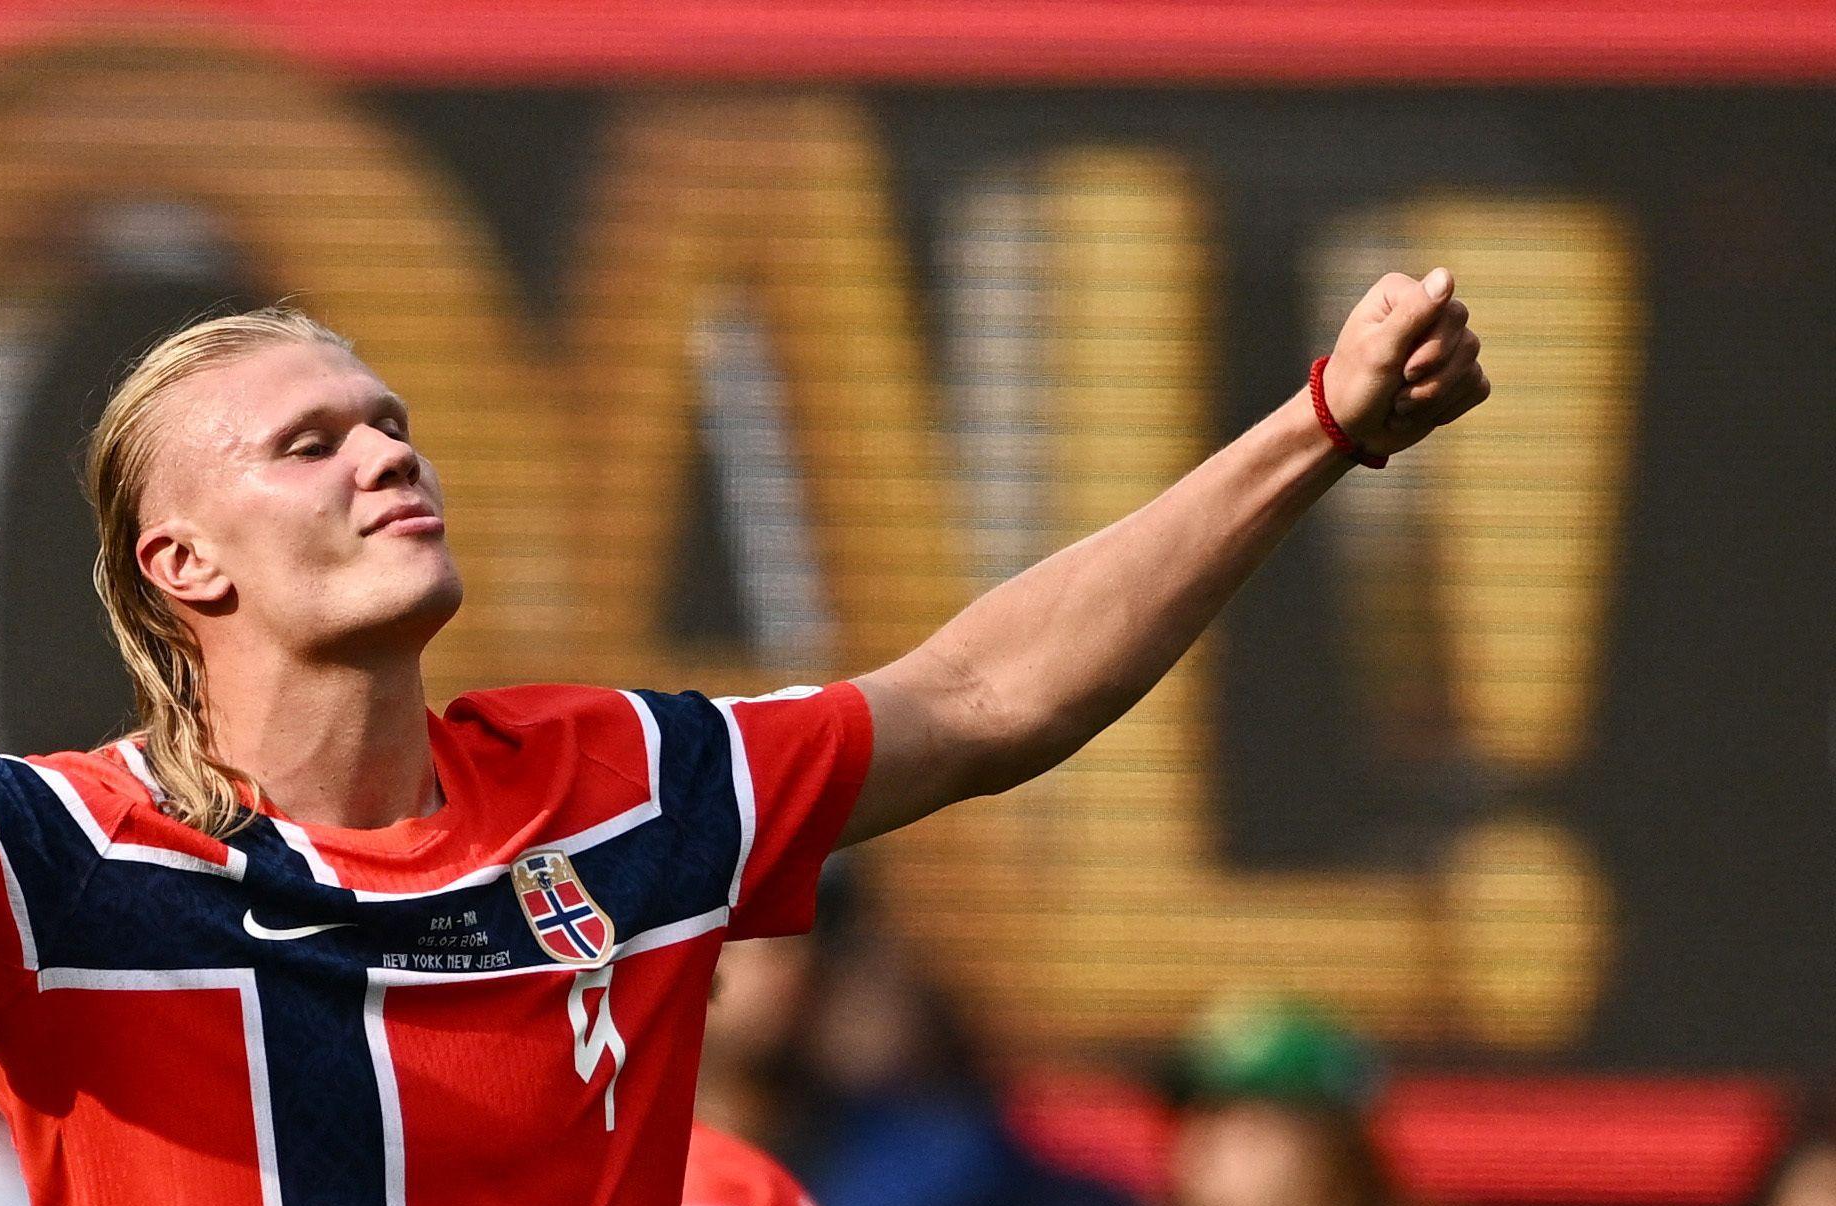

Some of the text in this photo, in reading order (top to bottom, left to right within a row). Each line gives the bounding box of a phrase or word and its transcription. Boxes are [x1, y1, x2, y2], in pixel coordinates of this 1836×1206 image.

[382, 953, 408, 969] NEW
[412, 954, 443, 969] YORK
[446, 954, 473, 969] NEW
[567, 964, 626, 1132] 9
